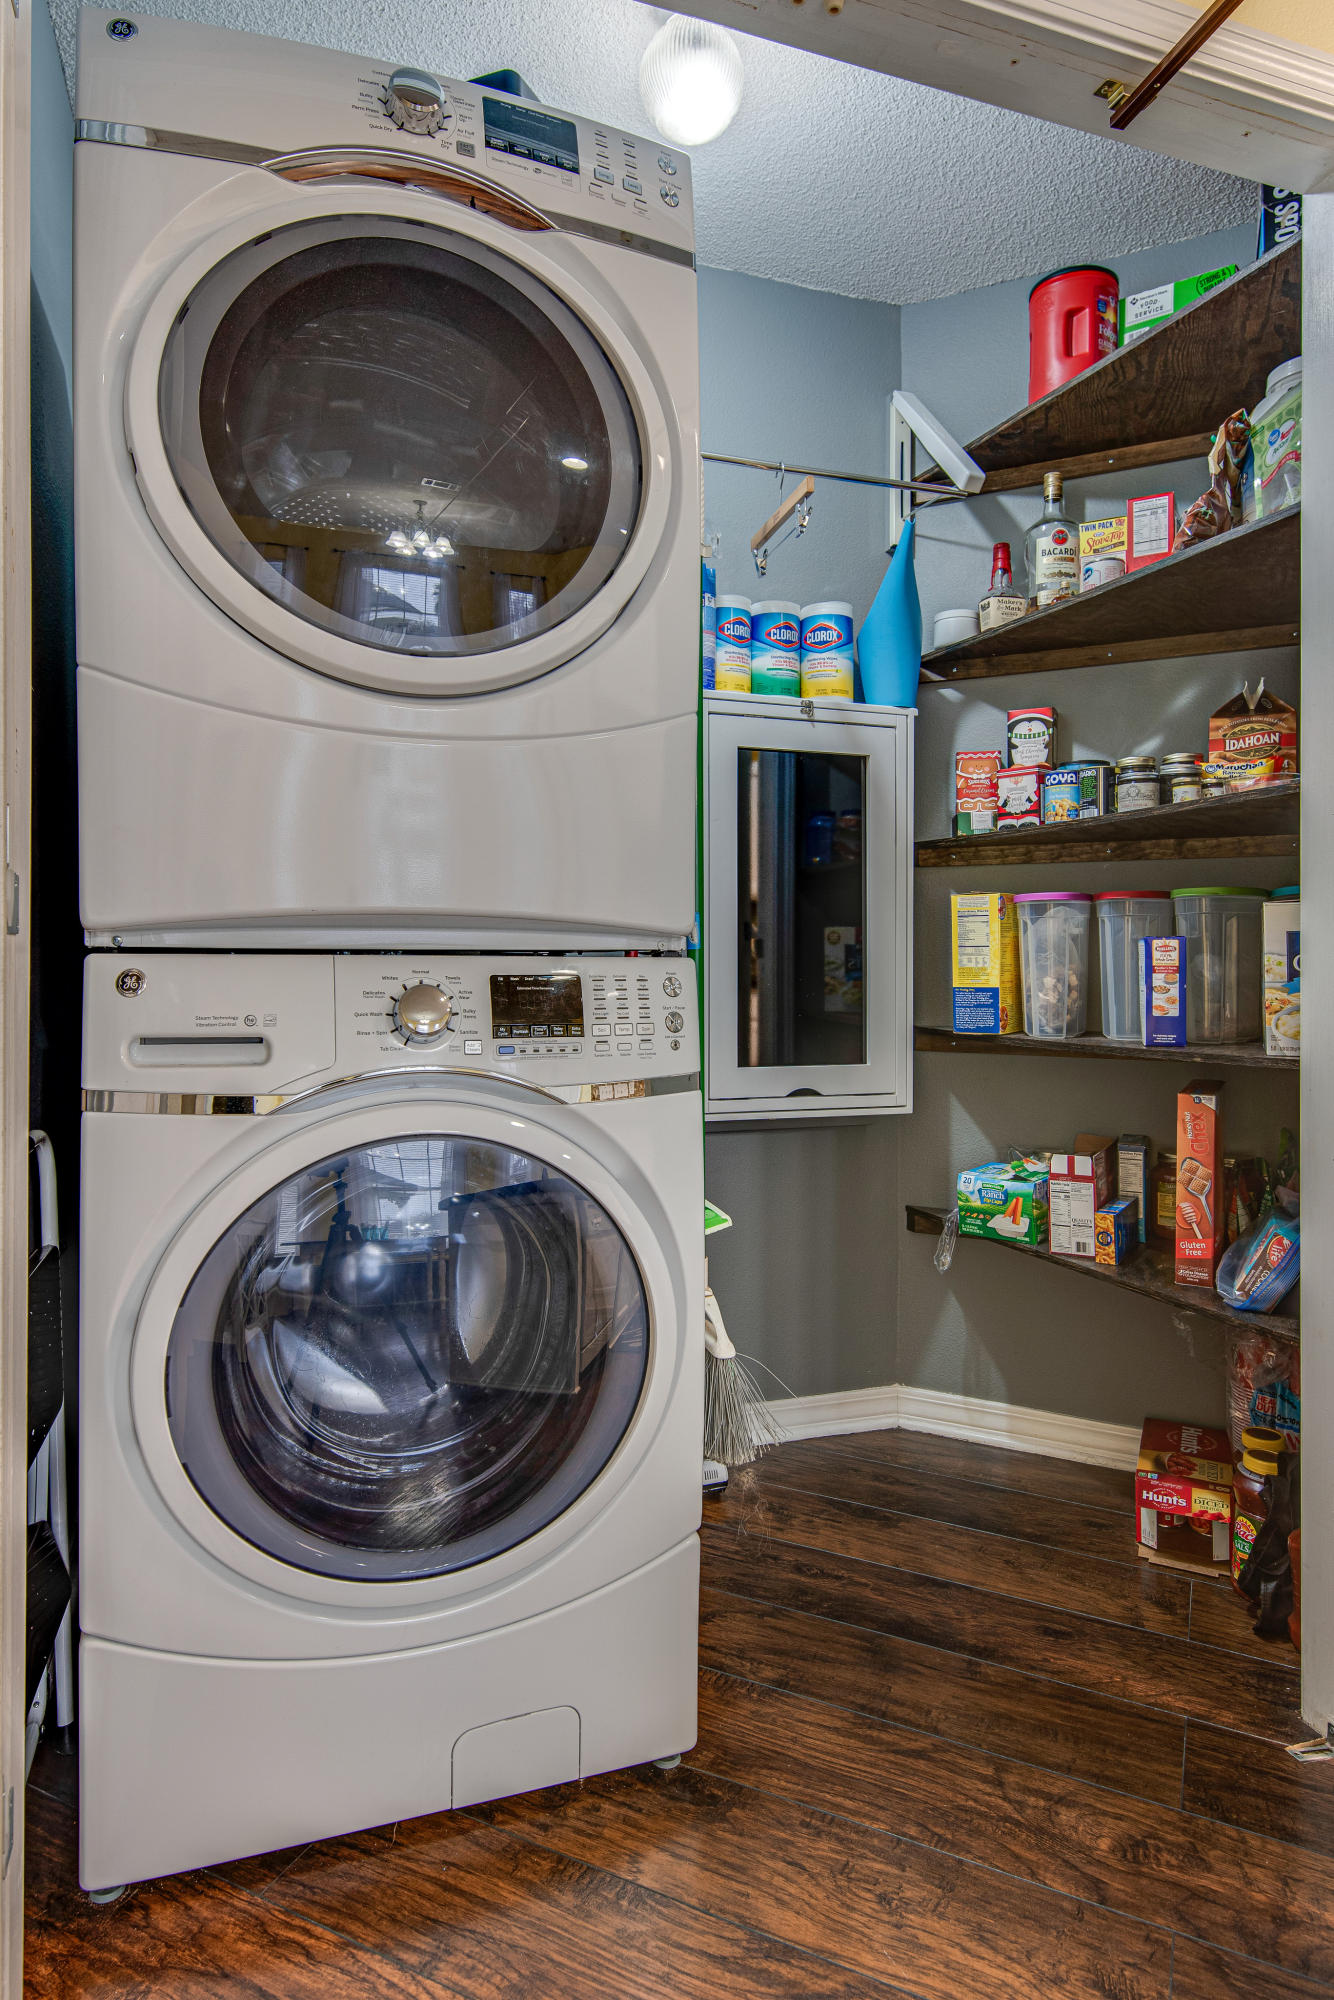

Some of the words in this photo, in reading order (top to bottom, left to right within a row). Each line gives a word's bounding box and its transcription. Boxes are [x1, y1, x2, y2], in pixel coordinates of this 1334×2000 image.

[369, 123, 382, 131] Quick
[1199, 271, 1221, 287] STRONG
[1134, 305, 1164, 319] SERVICE
[1098, 323, 1116, 342] Folg
[1080, 522, 1097, 533] TWIN
[1098, 519, 1114, 530] PACK
[1083, 533, 1110, 554] Stove
[997, 598, 1023, 606] Maker's
[724, 623, 750, 638] CLORO
[806, 632, 838, 643] CLOROX
[1225, 732, 1280, 751] IDAHOAN
[1215, 760, 1265, 772] Maruchan
[1045, 772, 1077, 786] GOYA
[1191, 1112, 1210, 1155] Chex
[963, 1176, 972, 1185] 20
[981, 1189, 1005, 1200] Ranch
[1180, 1240, 1206, 1249] Gluten
[1185, 1248, 1203, 1256] Free
[1256, 1394, 1277, 1406] HEA
[1255, 1402, 1277, 1414] DUT
[1193, 1497, 1229, 1510] DICED
